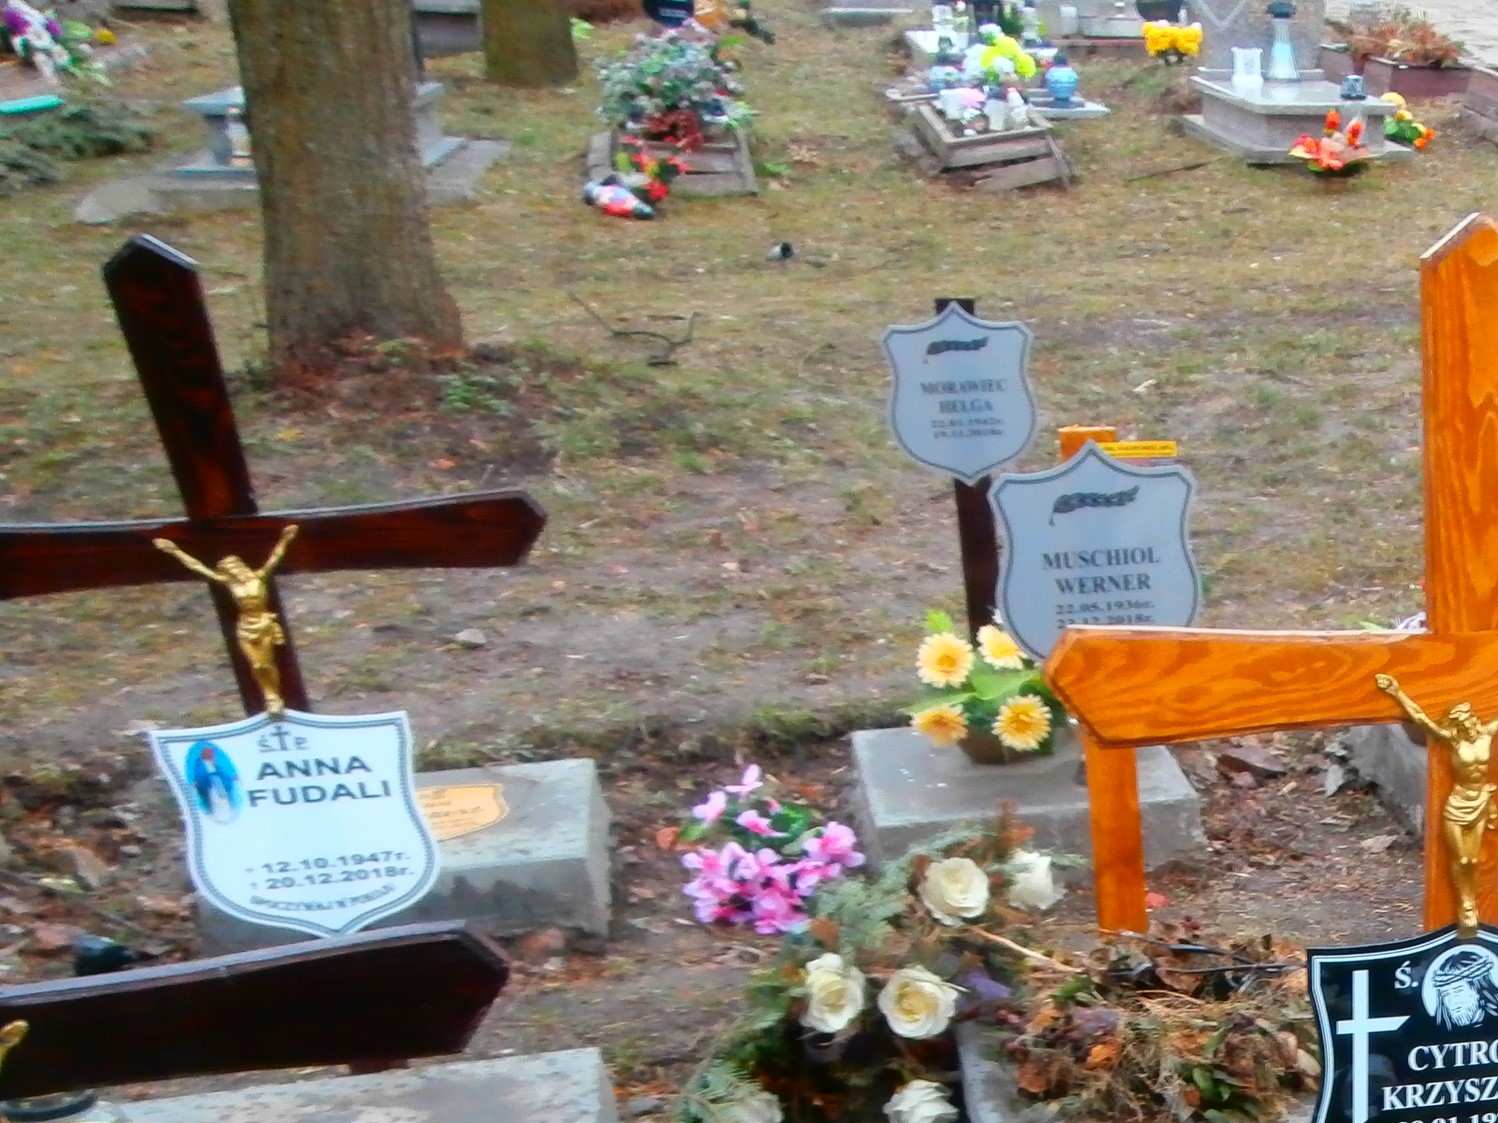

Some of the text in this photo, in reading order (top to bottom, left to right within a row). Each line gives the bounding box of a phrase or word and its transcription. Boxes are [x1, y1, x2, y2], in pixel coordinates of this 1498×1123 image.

[938, 399, 994, 414] HELGA
[1042, 547, 1159, 570] MUSCHIOL
[1055, 573, 1151, 594] WERNER
[257, 756, 373, 781] ANNA
[247, 780, 392, 807] FUDALI
[262, 851, 411, 873] 12.10.1947r.
[1394, 960, 1419, 990] Ś.
